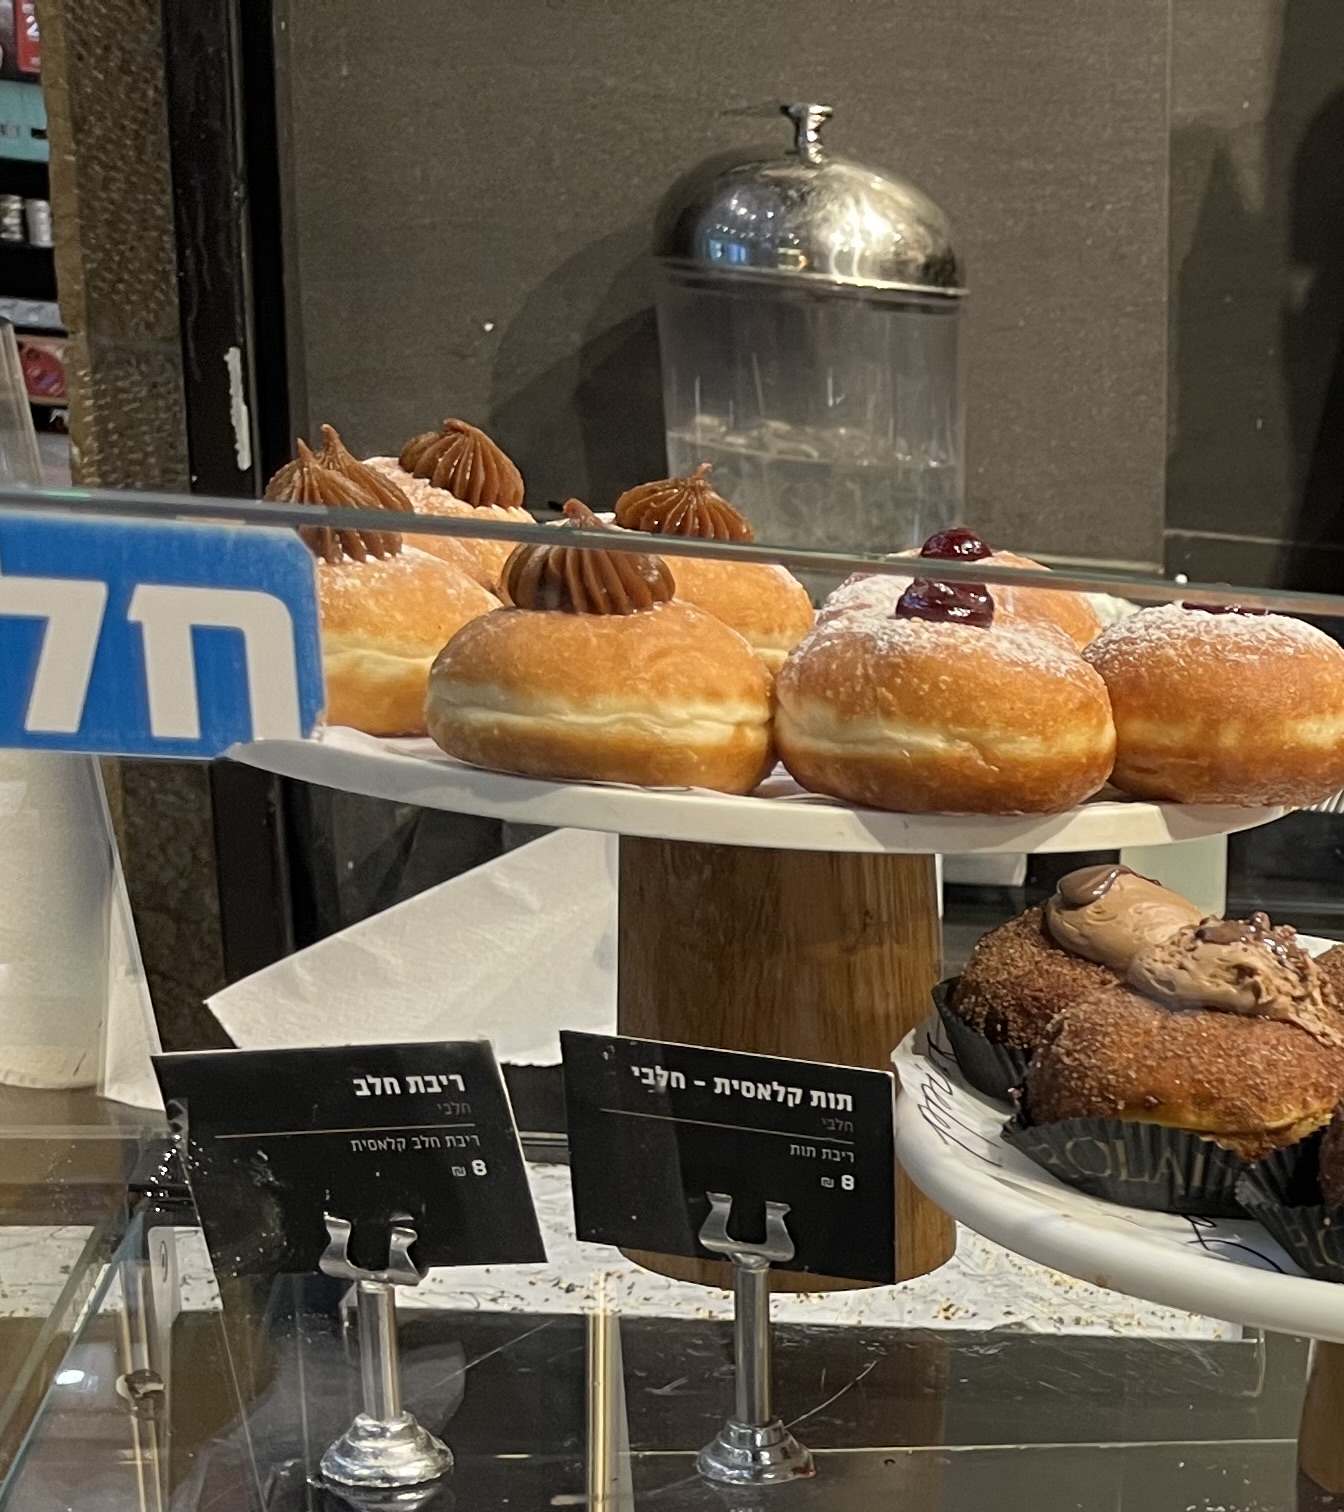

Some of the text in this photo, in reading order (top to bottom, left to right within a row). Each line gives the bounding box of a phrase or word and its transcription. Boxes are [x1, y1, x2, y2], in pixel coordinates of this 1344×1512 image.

[353, 1075, 465, 1096] ריבת חלב
[631, 1066, 852, 1111] תות קלאסית חלבי
[437, 1101, 471, 1115] חלבי
[822, 1118, 853, 1132] חלבי
[351, 1135, 480, 1151] ריבת חלב קלאסית
[790, 1145, 854, 1162] ריבת תות
[471, 1159, 487, 1176] 8
[841, 1174, 855, 1190] 8
